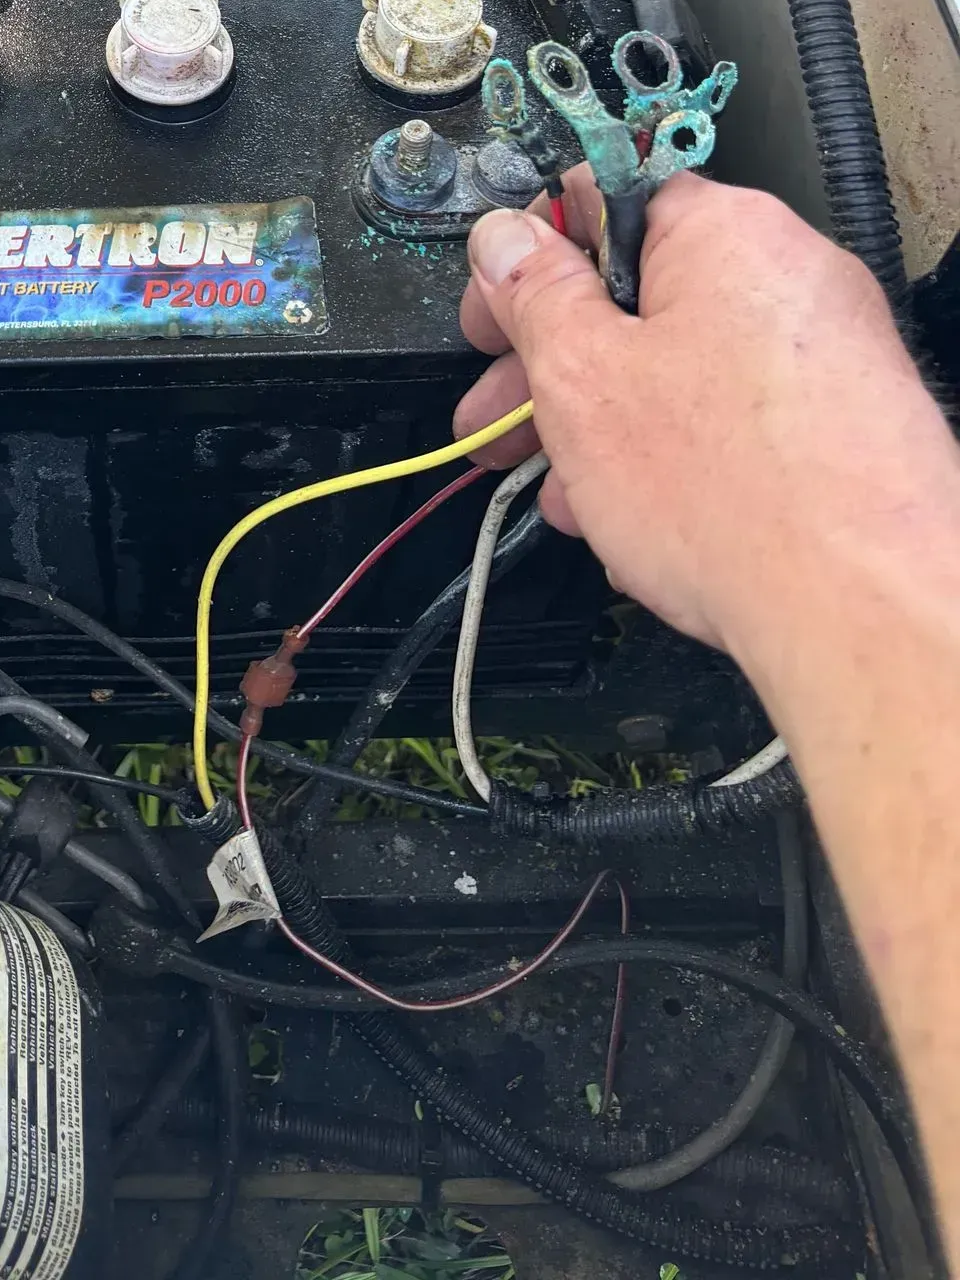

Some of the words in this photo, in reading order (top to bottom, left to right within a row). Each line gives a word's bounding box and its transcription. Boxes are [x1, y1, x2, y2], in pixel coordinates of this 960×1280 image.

[14, 279, 100, 296] BATTERY
[143, 278, 268, 309] P2000
[2, 929, 18, 1008] performance
[14, 940, 28, 1017] performance
[23, 939, 38, 1014] performance
[33, 952, 45, 988] slowly
[39, 991, 47, 1018] runs
[46, 975, 58, 1022] stopped
[62, 985, 74, 1029] position
[8, 1009, 18, 1055] Vehicle
[18, 1019, 28, 1059] Regen
[28, 1017, 37, 1063] Vehicle
[38, 1020, 47, 1066] Vehicle
[47, 1024, 56, 1070] Vehicle
[57, 1023, 66, 1036] to
[70, 1019, 80, 1042] exit
[58, 1037, 68, 1076] switch
[59, 1076, 70, 1097] key
[65, 1076, 76, 1129] position
[10, 1097, 19, 1146] voltage
[19, 1097, 29, 1147] voltage
[59, 1100, 68, 1127] Turn
[28, 1123, 38, 1176] cutback
[38, 1127, 48, 1175] welded
[58, 1145, 67, 1180] mode
[66, 1132, 75, 1175] neutral
[72, 1129, 82, 1159] fault
[7, 1149, 19, 1199] battery
[17, 1148, 29, 1197] battery
[64, 1177, 75, 1208] from
[71, 1173, 82, 1207] when
[0, 1200, 14, 1229] Low
[10, 1200, 24, 1231] High
[20, 1178, 37, 1234] Thermal
[31, 1177, 47, 1237] Solenoid
[41, 1200, 55, 1241] Motor
[48, 1151, 58, 1198] stalled
[50, 1182, 68, 1248] diagnostic
[58, 1209, 72, 1249] switch
[67, 1208, 81, 1246] sound
[58, 1248, 70, 1269] will
